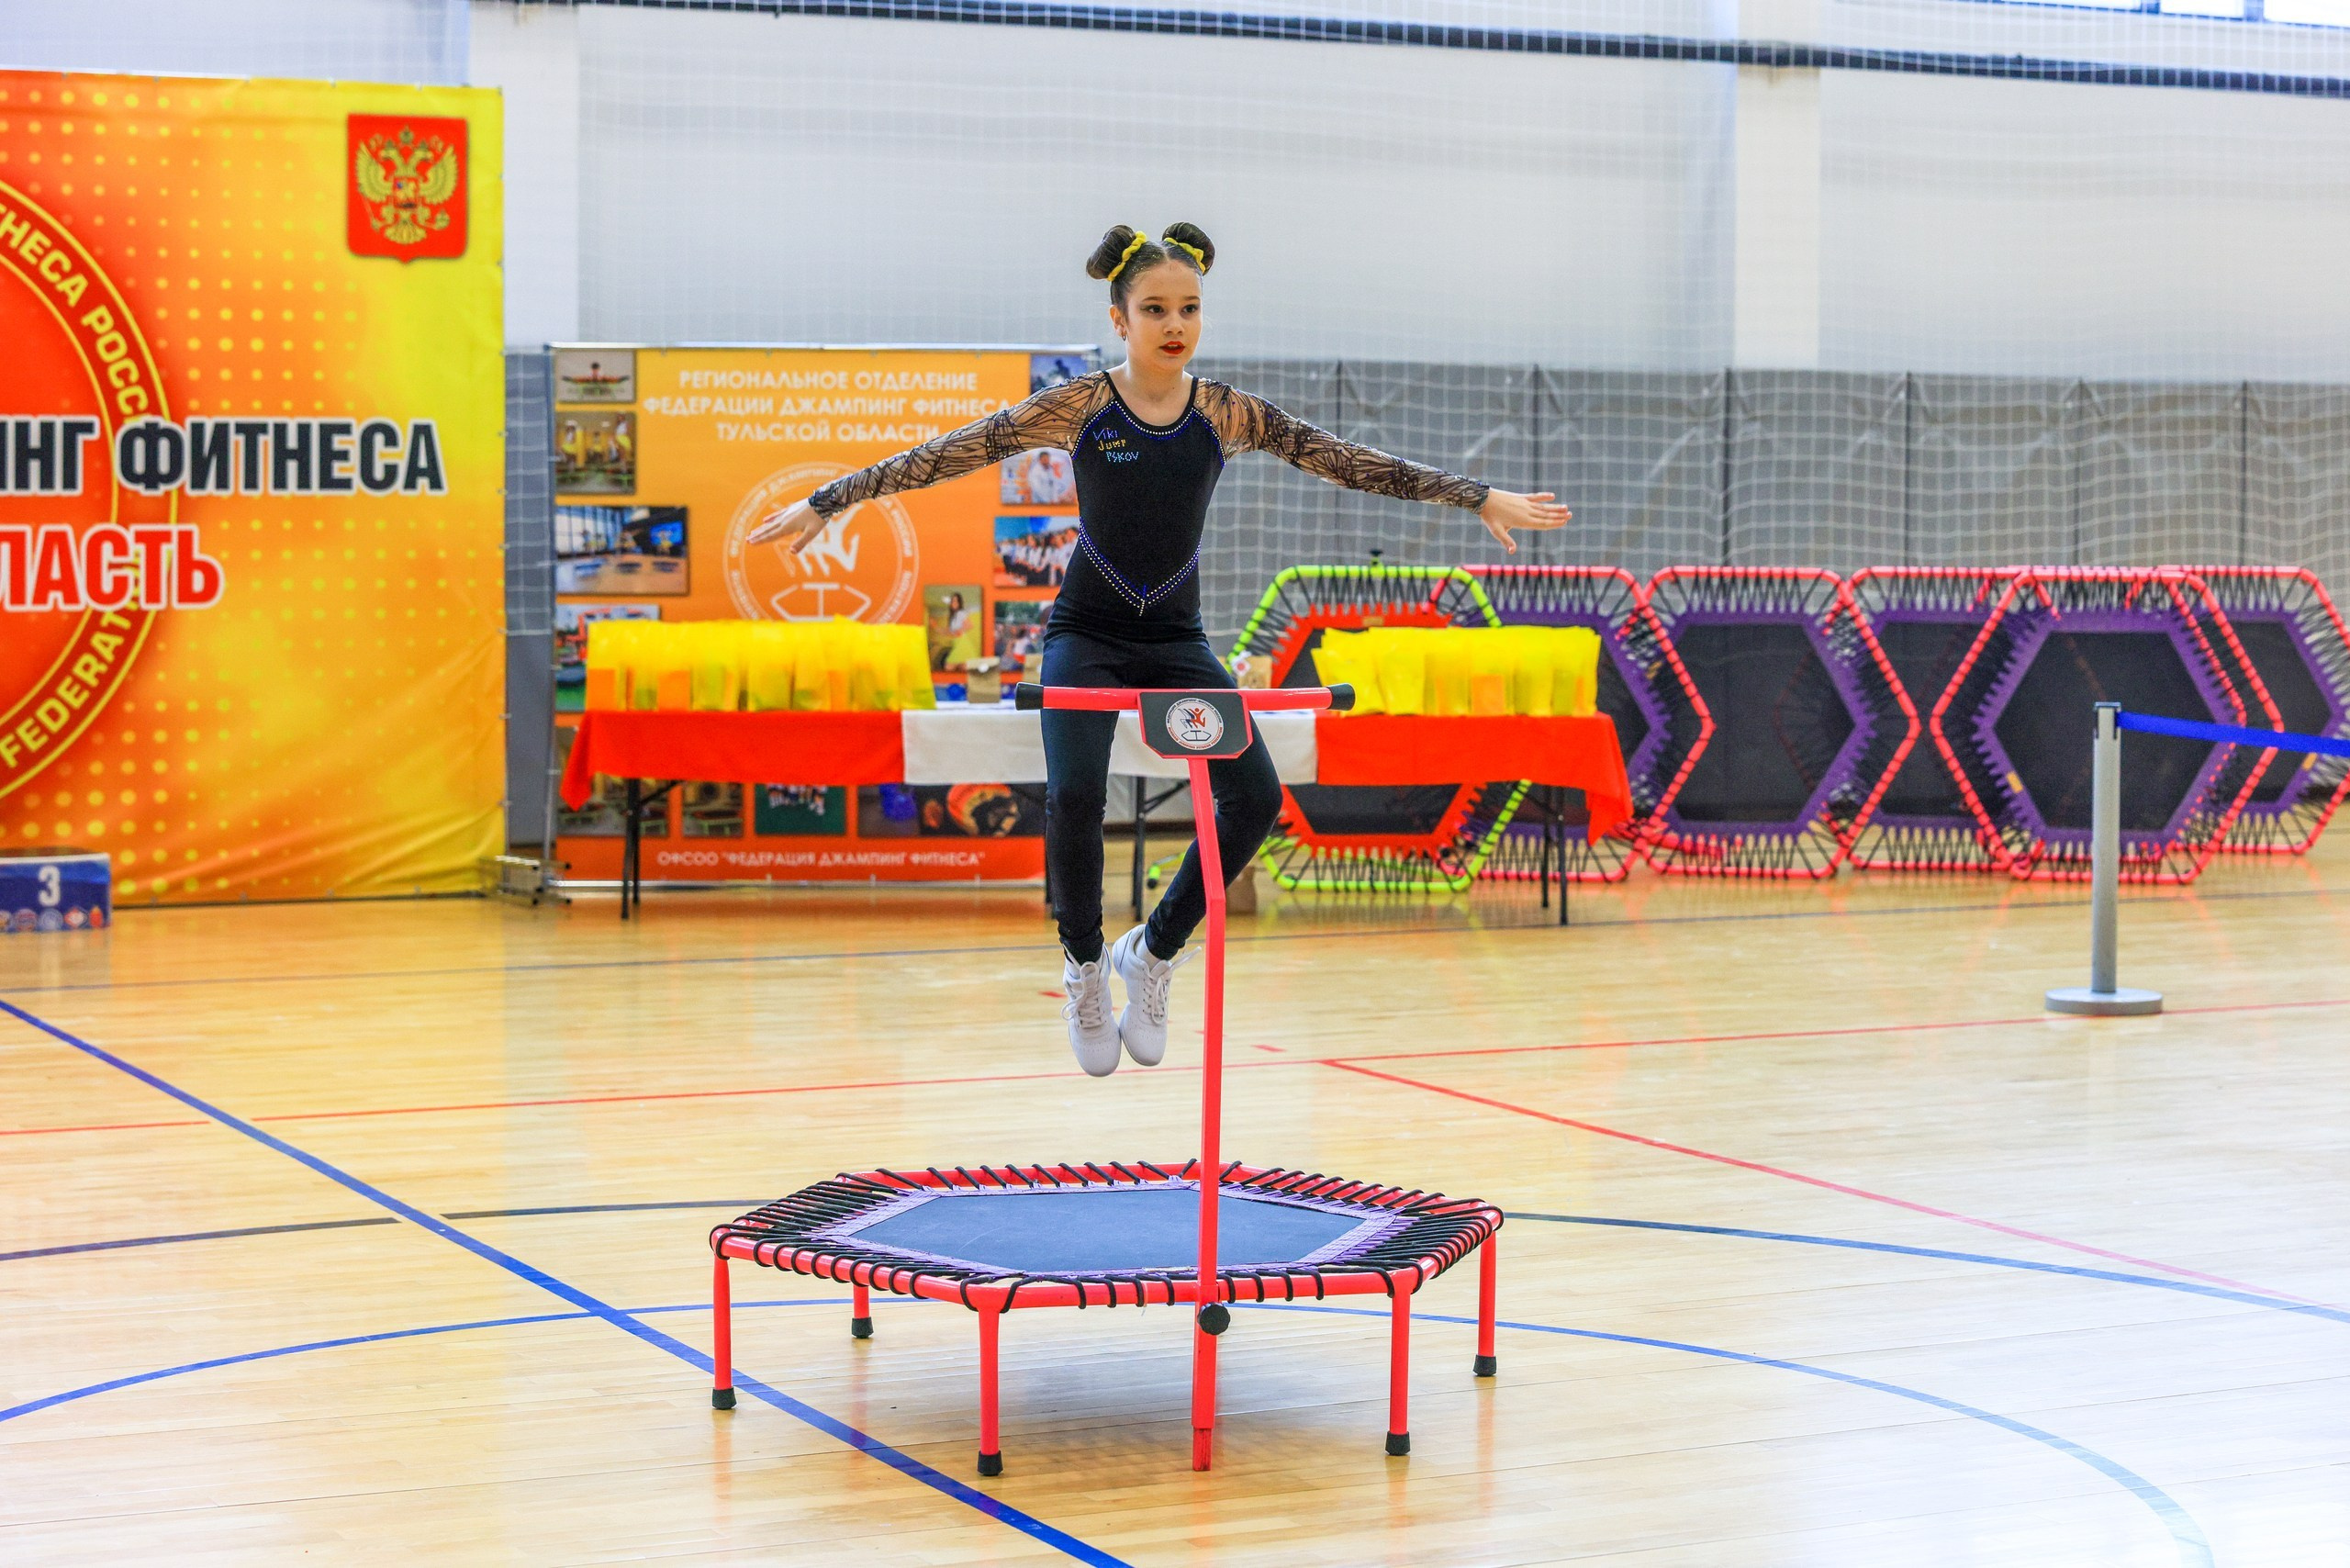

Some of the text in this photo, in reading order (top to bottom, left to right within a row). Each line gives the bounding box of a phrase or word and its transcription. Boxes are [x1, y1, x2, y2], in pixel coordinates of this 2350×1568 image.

[0, 202, 154, 425] НЕСА РОСС
[678, 370, 979, 392] РЕГИОНАЛЬНОЕ ОТДЕЛЕНИЕ
[643, 396, 774, 417] ФЕДЕРАЦИИ
[778, 397, 908, 417] ДЖАМПИНГ
[716, 419, 940, 442] ТУЛЬСКОЙ ОБЛАСТИ
[0, 418, 447, 494] НГ ФИТНЕСА
[656, 851, 719, 866] ОФСОО
[817, 851, 905, 867] ДЖАМПИНГ
[39, 865, 61, 907] 3
